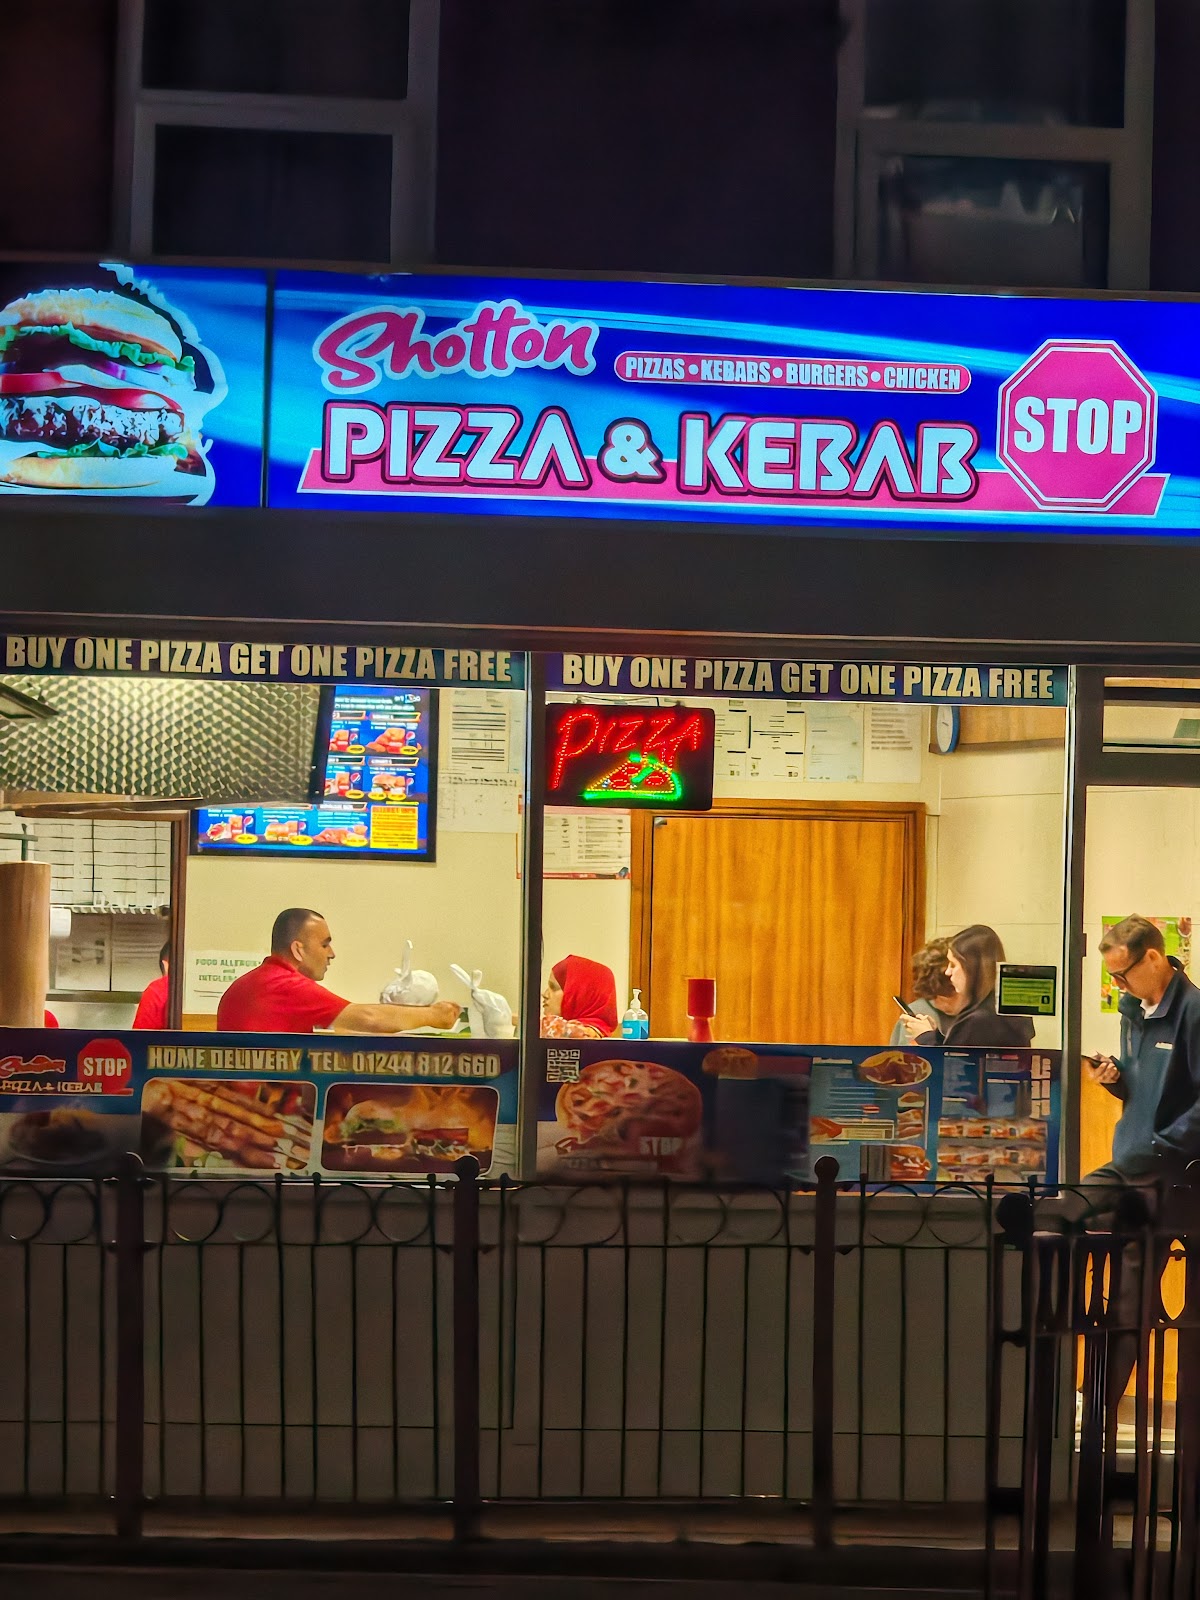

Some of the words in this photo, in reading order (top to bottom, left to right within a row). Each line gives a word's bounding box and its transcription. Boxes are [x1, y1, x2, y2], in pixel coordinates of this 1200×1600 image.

[313, 299, 599, 394] Shotton
[626, 356, 685, 380] PIZZAS
[701, 359, 771, 383] KEBABS
[786, 363, 868, 387] BURGERS
[883, 366, 960, 390] CHICKEN
[1013, 396, 1143, 455] STOP
[325, 405, 588, 485] PIZZA
[603, 419, 660, 480] &
[683, 415, 977, 498] KEBAB
[6, 636, 66, 668] BUY
[73, 640, 133, 671] ONE
[140, 641, 222, 674] PIZZA
[229, 643, 284, 675] GET
[290, 645, 348, 677] ONE
[355, 647, 436, 679] PIZZA
[444, 650, 511, 682] FREE
[563, 653, 623, 687] BUY
[630, 657, 687, 689] ONE
[694, 659, 774, 692] PIZZA
[780, 662, 834, 693] GET
[840, 664, 895, 695] ONE
[903, 665, 982, 698] PIZZA
[988, 668, 1054, 699] FREE
[549, 711, 702, 790] PIZZA
[83, 1057, 127, 1077] STOP
[148, 1046, 206, 1069] HOME
[210, 1048, 302, 1071] DELIVERY
